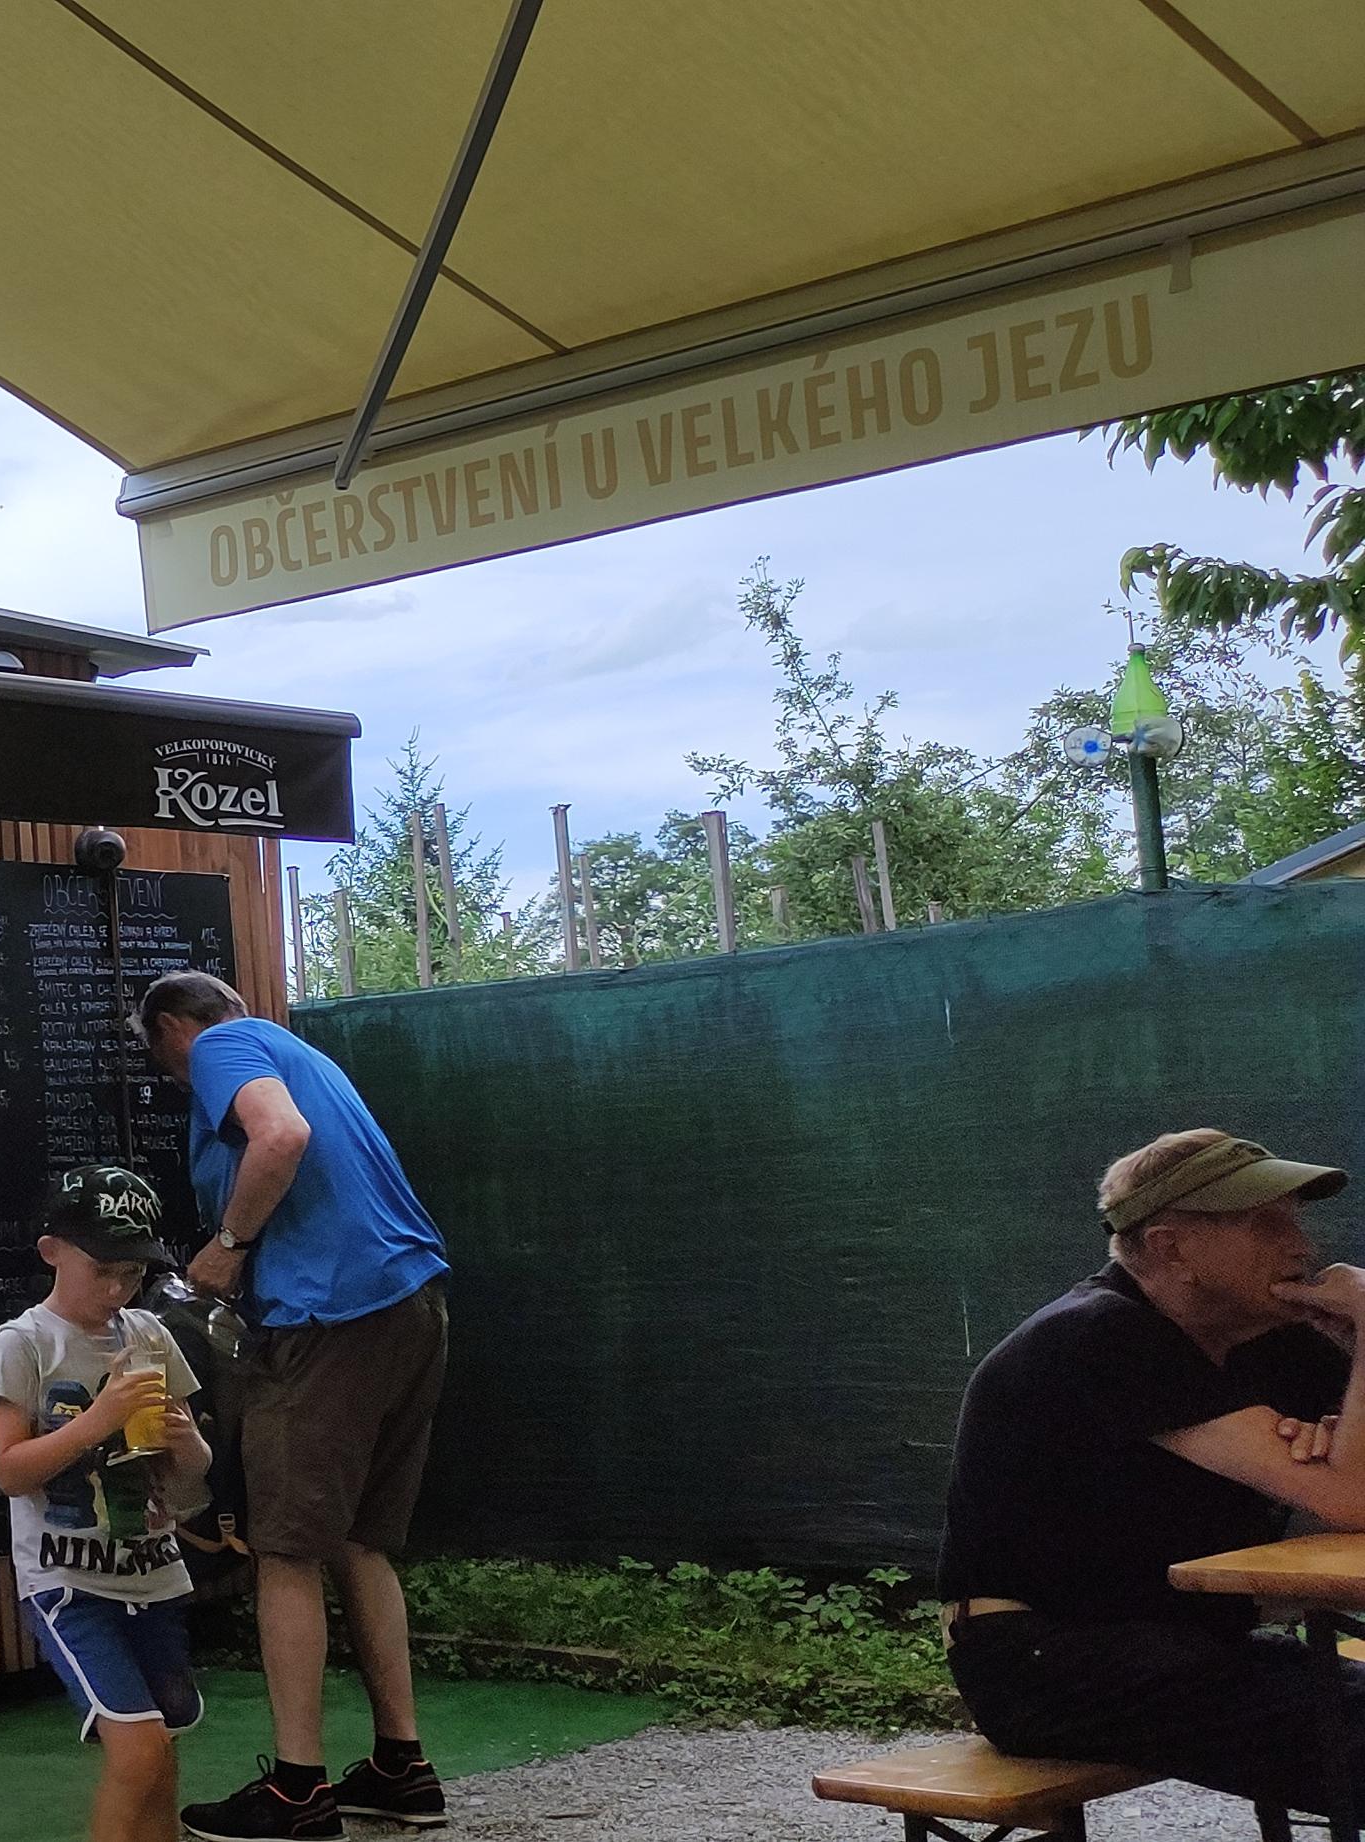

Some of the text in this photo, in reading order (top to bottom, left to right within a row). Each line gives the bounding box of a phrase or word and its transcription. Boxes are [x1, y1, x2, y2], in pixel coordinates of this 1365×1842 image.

[211, 293, 1153, 588] OBČERSTVENÍ U VELKÉHO JEZU
[154, 738, 278, 769] VELKOPOPOVICKÝ
[205, 753, 231, 766] 1874
[153, 766, 284, 827] Kozel
[95, 1189, 158, 1222] DARK
